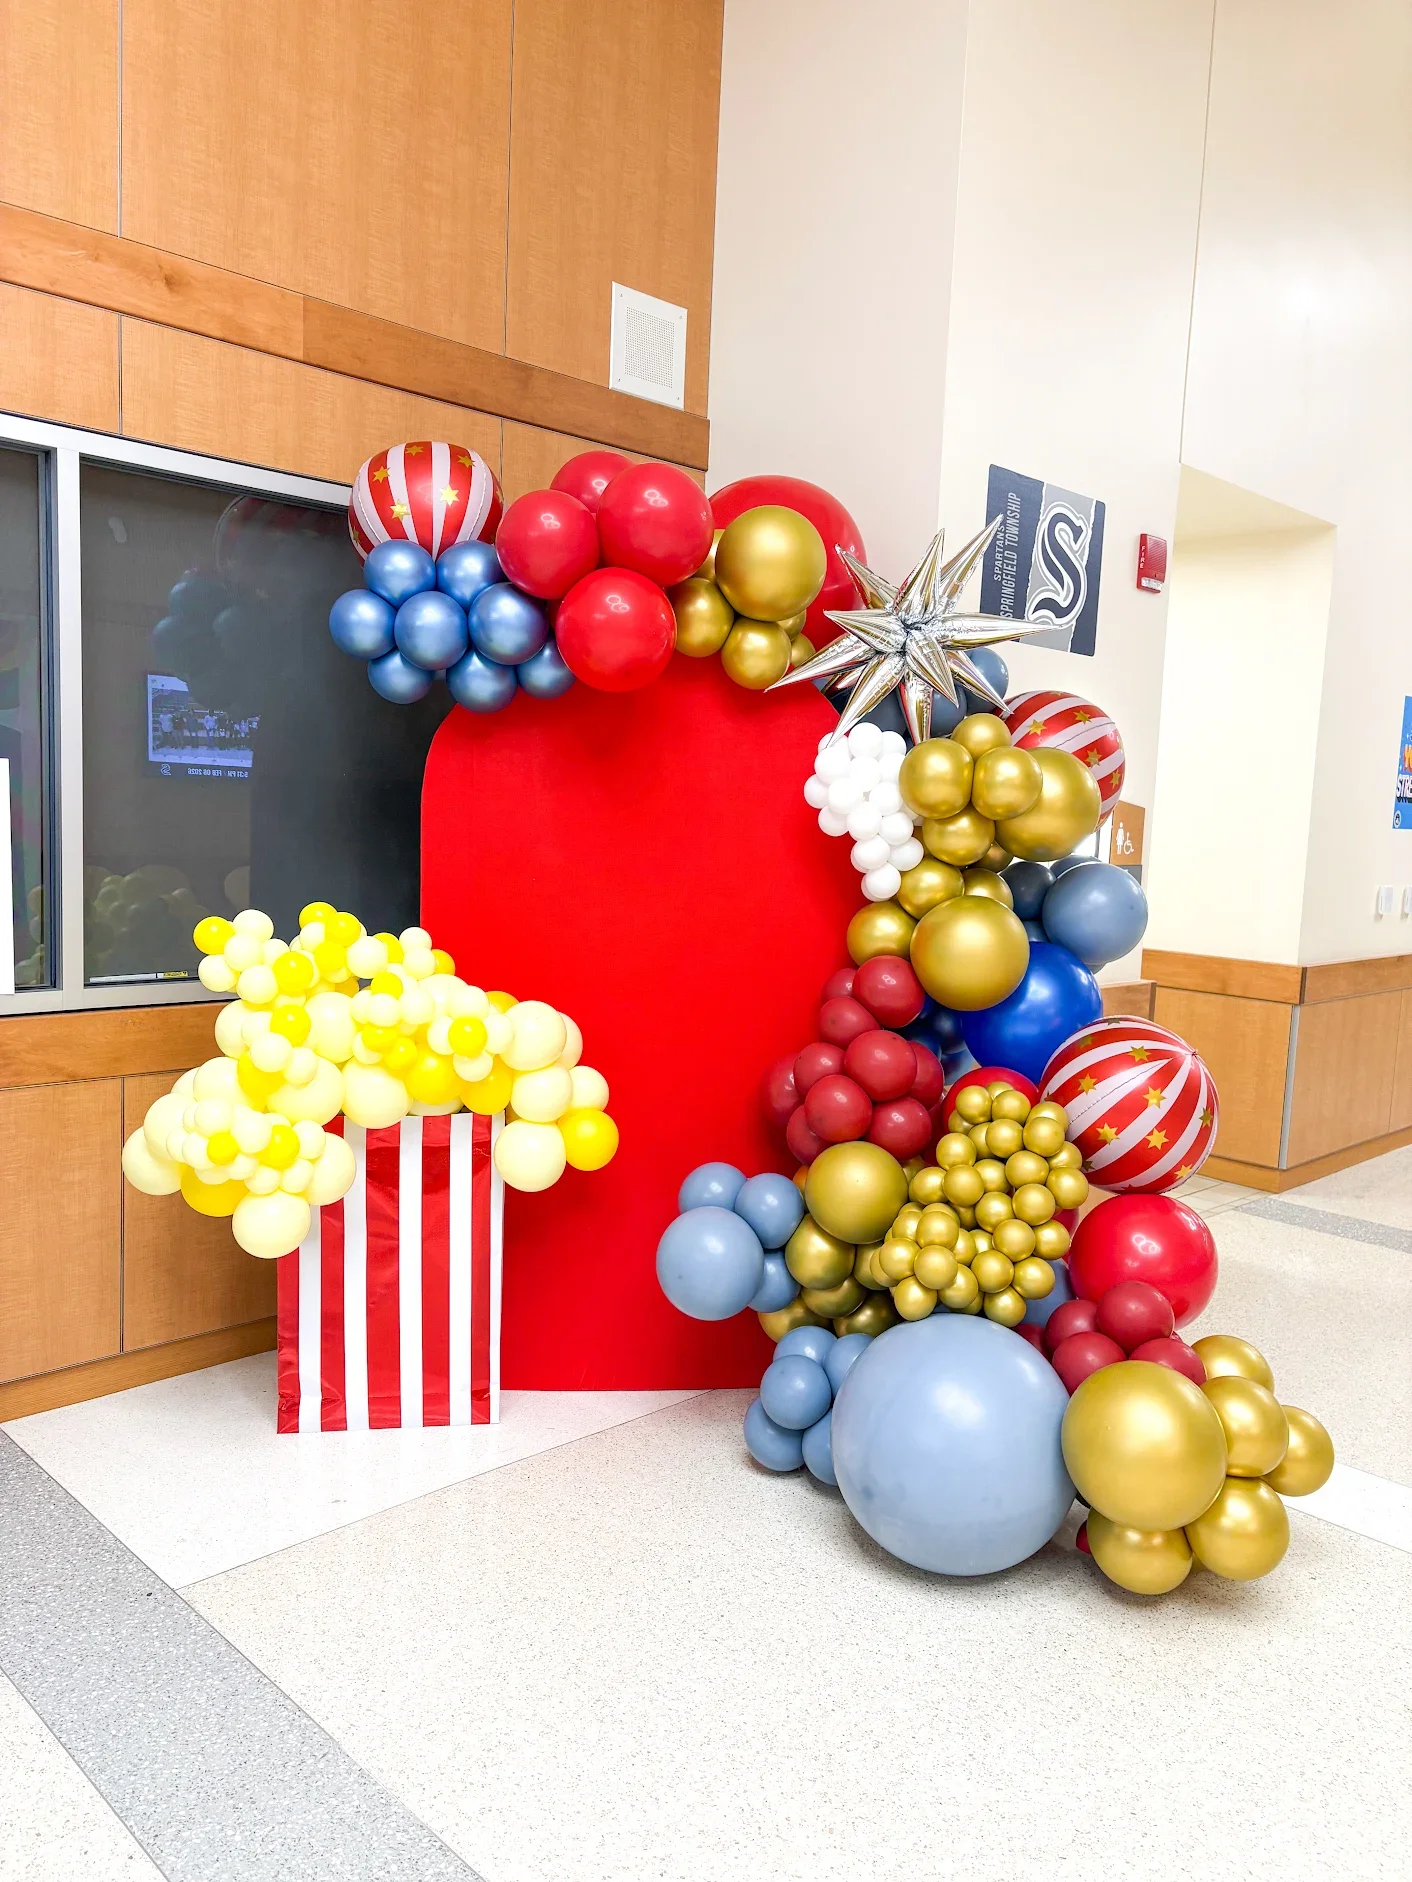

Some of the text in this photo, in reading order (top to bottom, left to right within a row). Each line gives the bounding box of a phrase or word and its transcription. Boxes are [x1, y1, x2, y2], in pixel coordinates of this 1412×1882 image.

[994, 524, 1006, 581] SPARTANS
[1000, 492, 1022, 619] SPRINGFIELD TOWNSHIP
